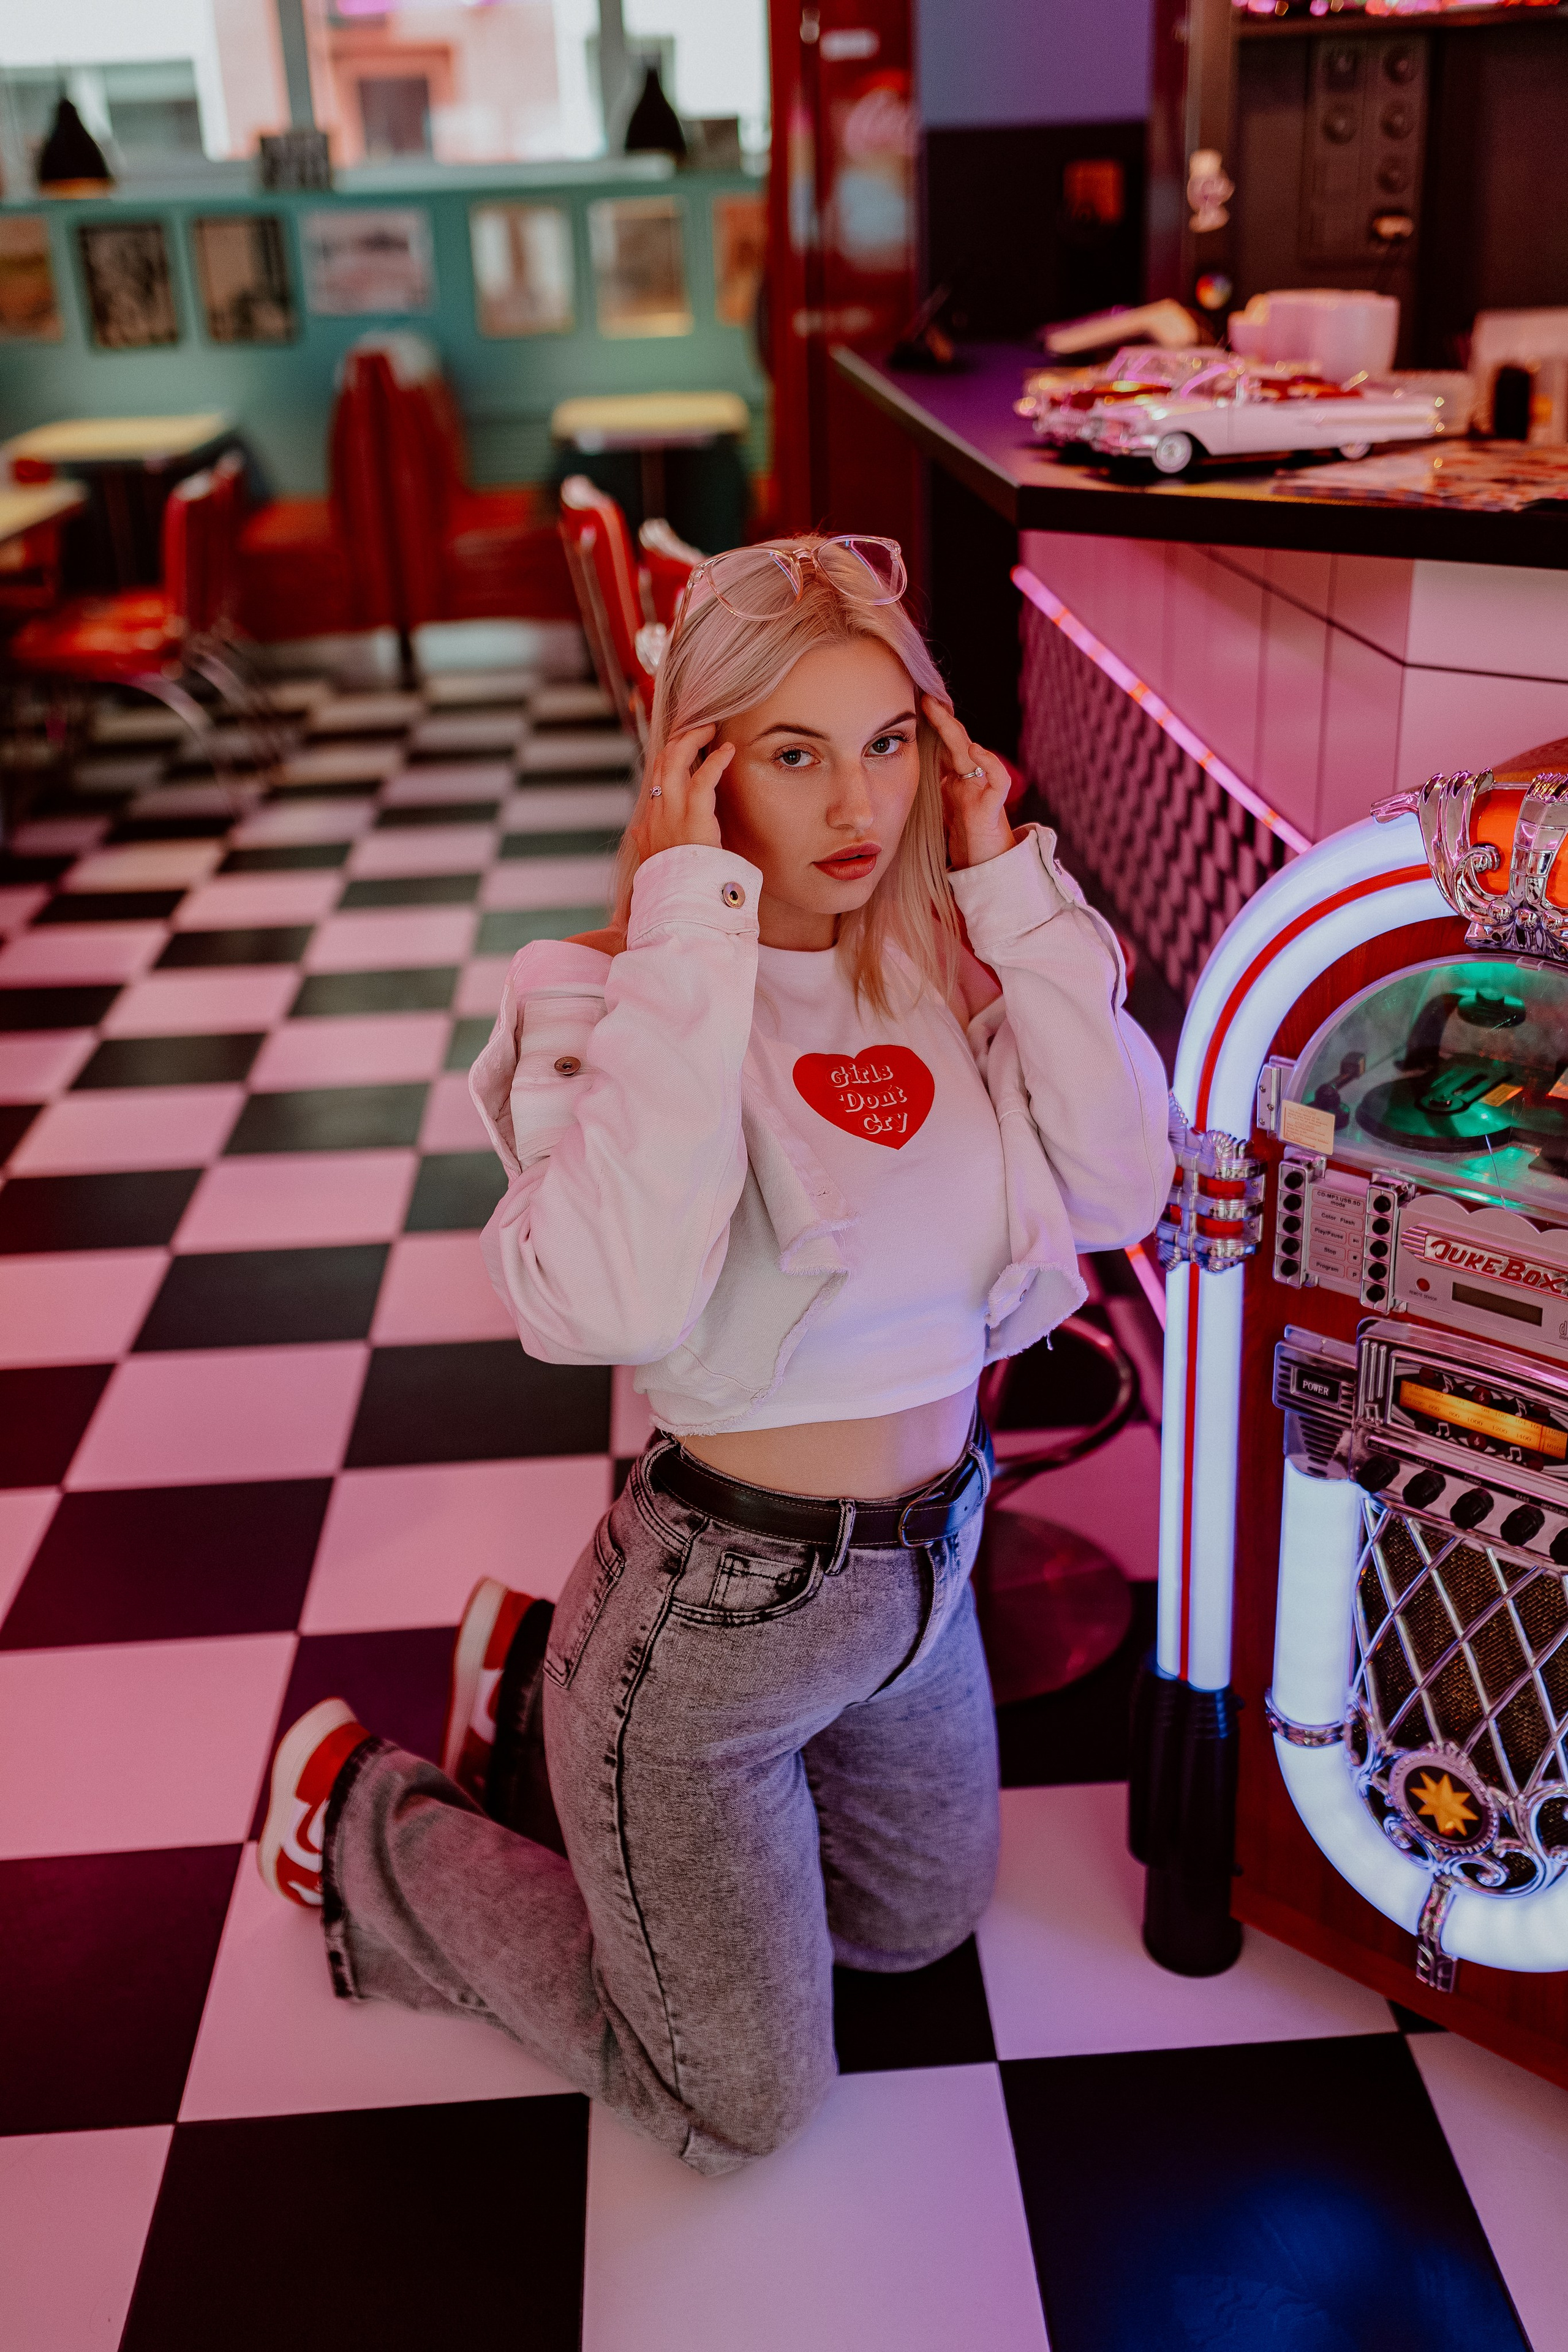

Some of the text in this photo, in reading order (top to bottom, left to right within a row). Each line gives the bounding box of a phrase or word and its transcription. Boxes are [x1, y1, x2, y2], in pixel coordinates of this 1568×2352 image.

[826, 1063, 894, 1088] Girls
[858, 1112, 908, 1134] Cry
[1314, 1227, 1343, 1240] Play/Pause
[1316, 1262, 1339, 1273] Program
[1303, 1380, 1329, 1396] POWER
[1468, 1418, 1483, 1427] 1000
[1492, 1425, 1507, 1434] 1200
[1370, 1442, 1389, 1452] VOLUME
[1415, 1458, 1434, 1468] TREBLE
[1515, 1494, 1529, 1503] BASS
